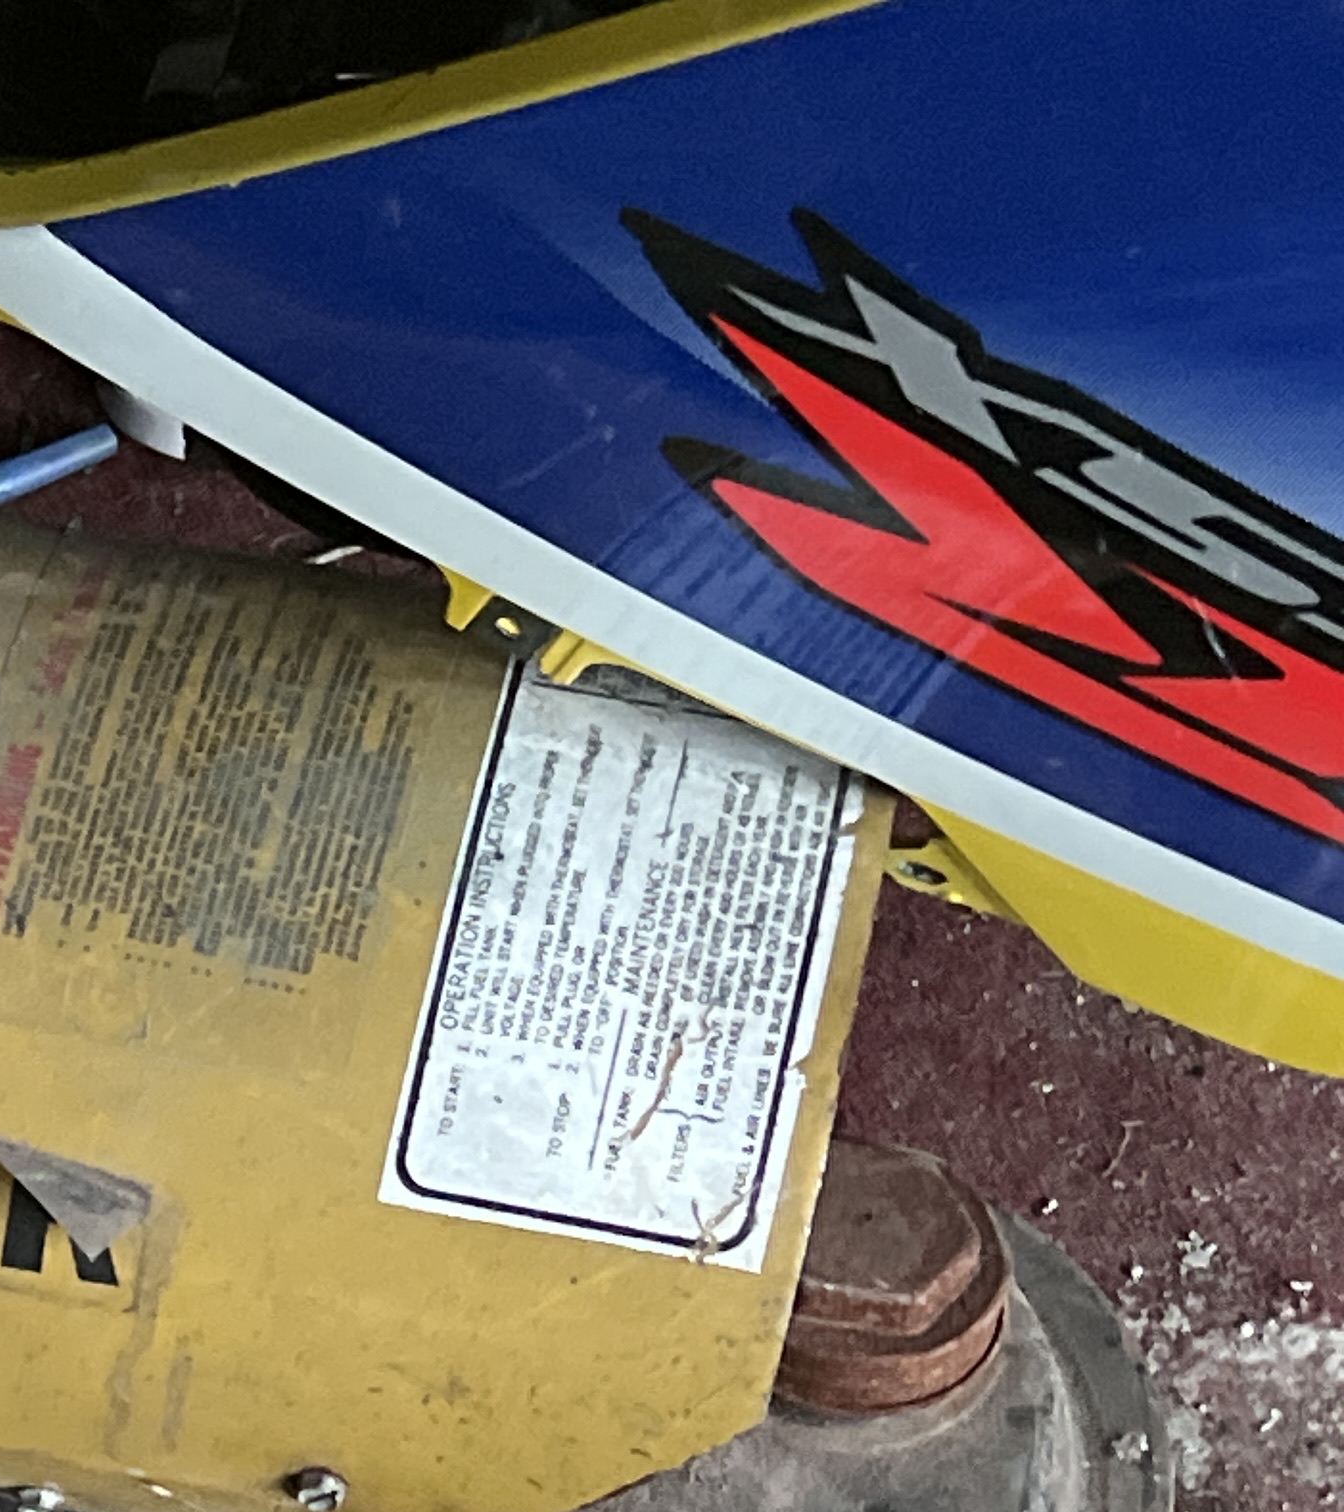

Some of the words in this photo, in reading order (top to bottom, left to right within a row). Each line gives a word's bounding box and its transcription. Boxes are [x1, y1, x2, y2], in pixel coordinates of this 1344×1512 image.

[438, 912, 484, 1031] OPERATION
[467, 779, 516, 910] INSTRUCTIONS
[496, 920, 518, 962] START
[620, 858, 669, 995] MAINTENANCE
[469, 966, 488, 999] FUEL
[461, 1002, 480, 1031] FILL
[711, 1074, 732, 1111] FUEL
[664, 1123, 692, 1183] FILTERS
